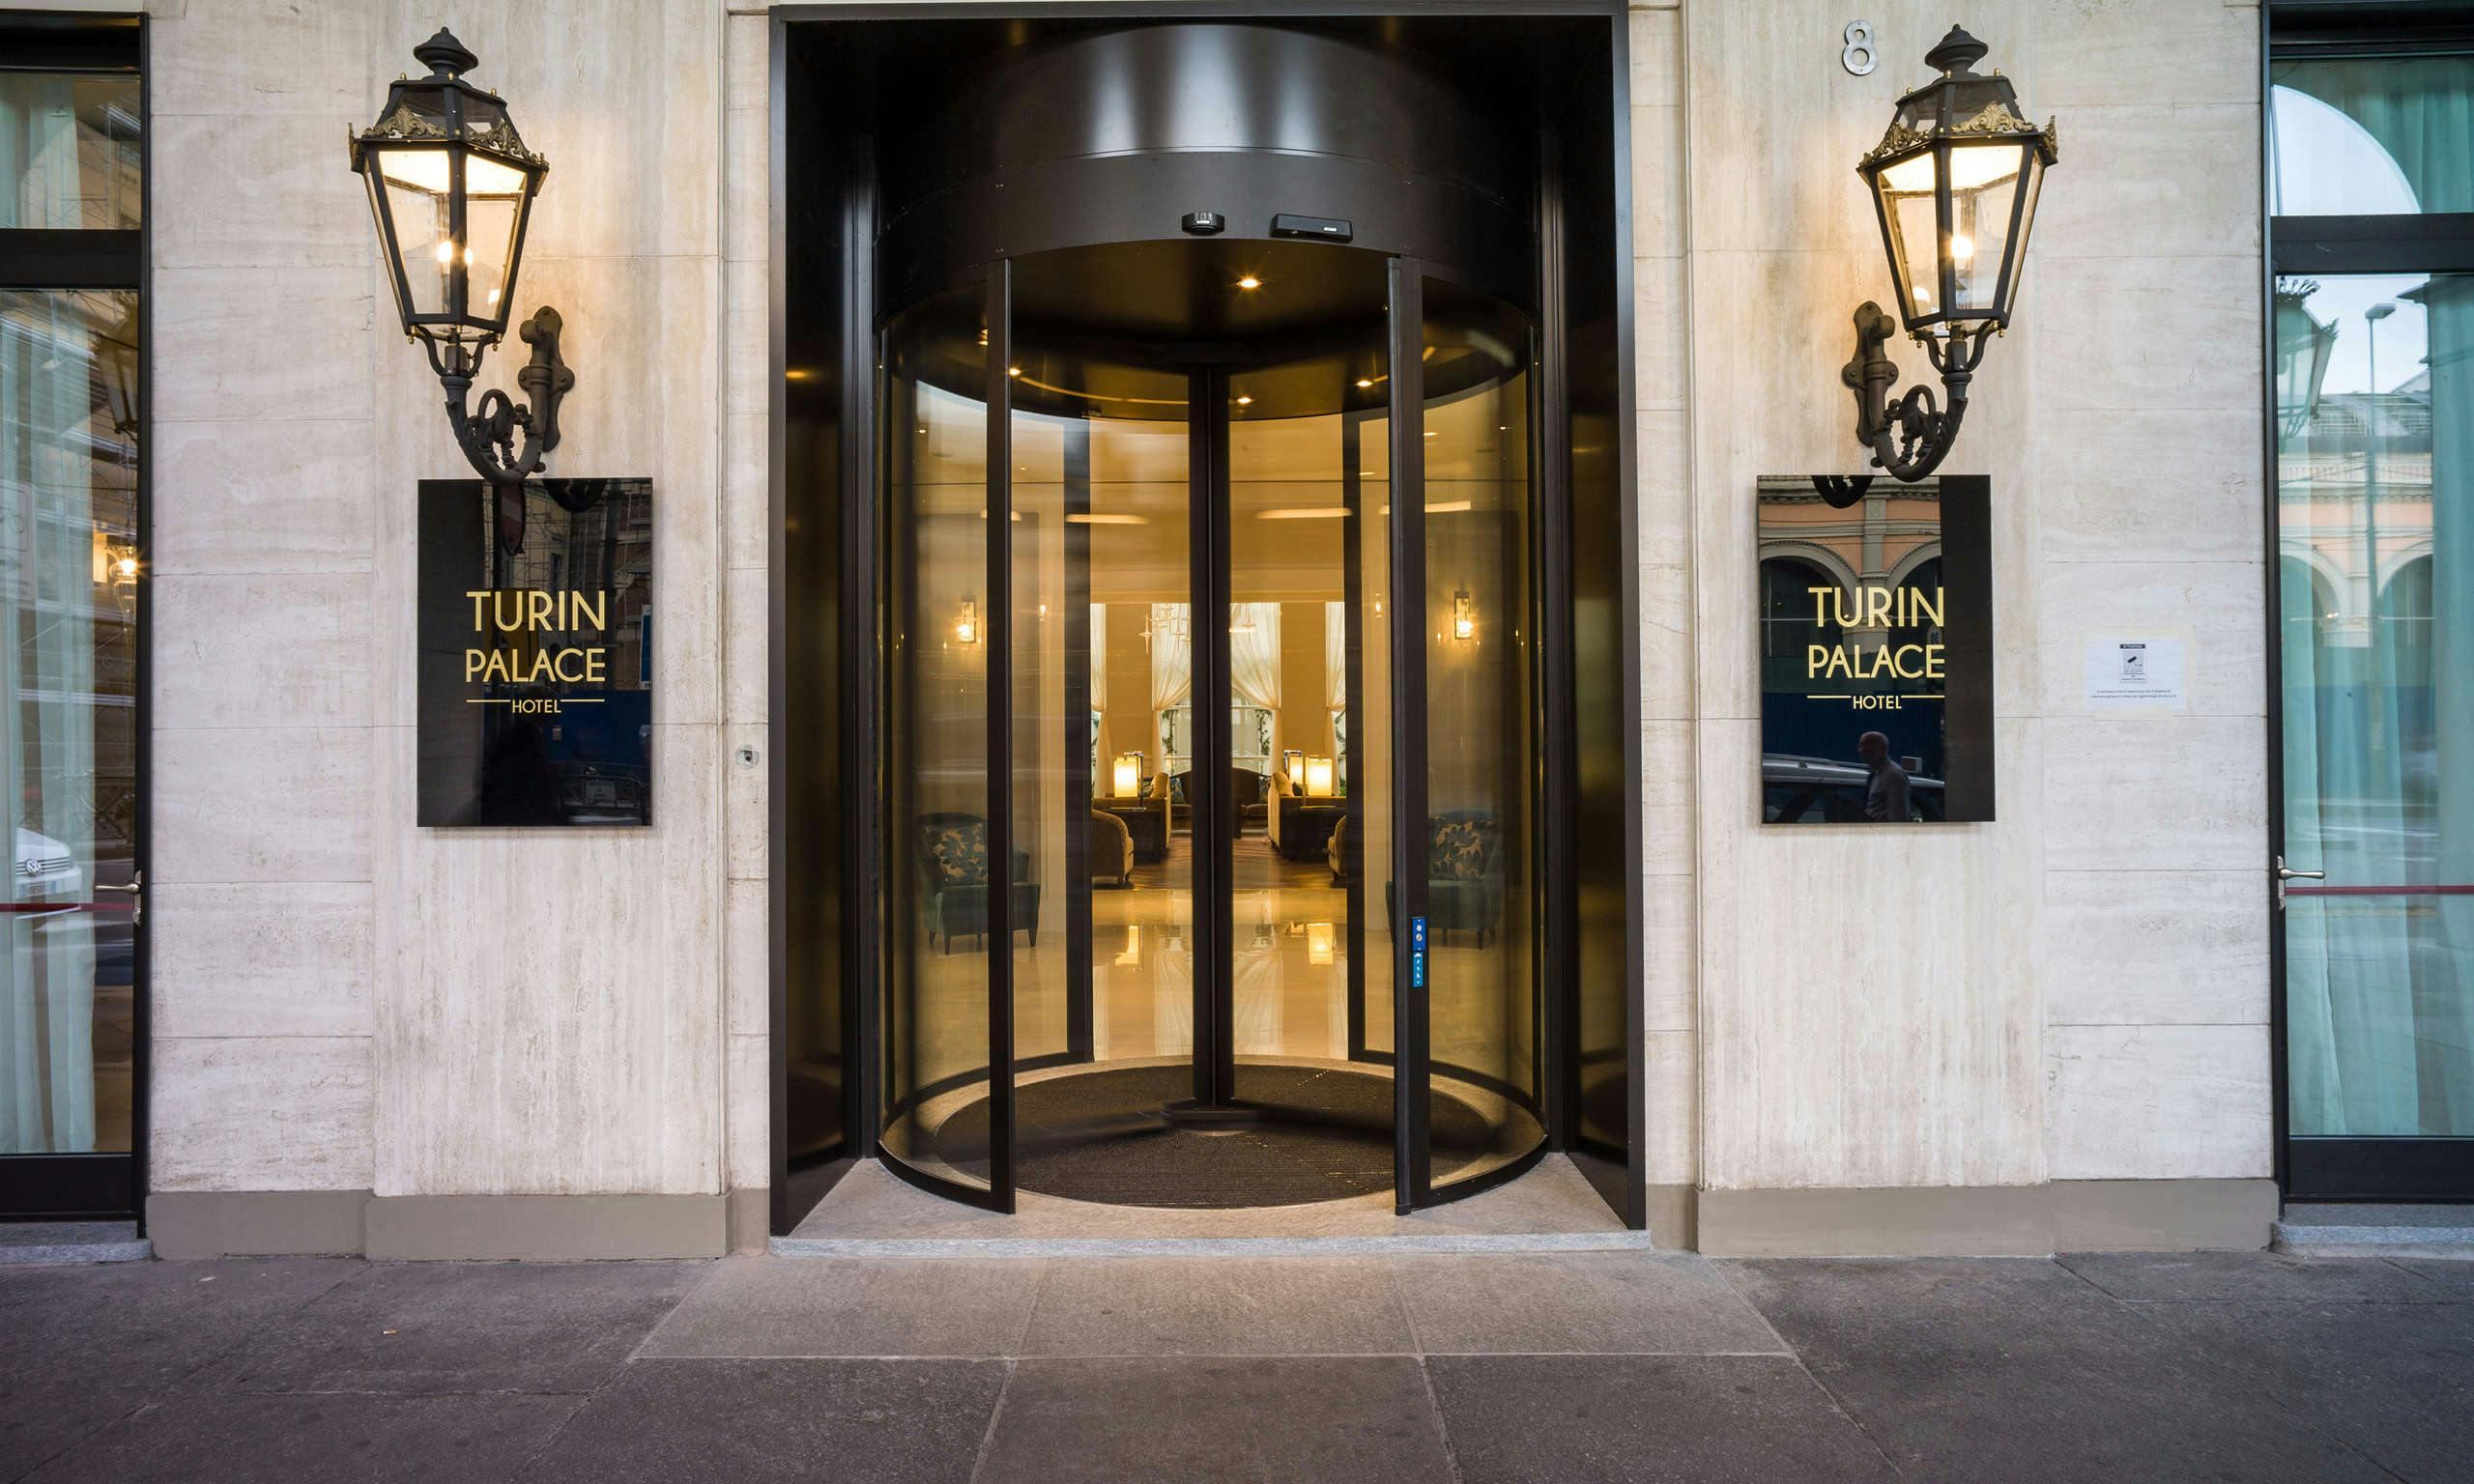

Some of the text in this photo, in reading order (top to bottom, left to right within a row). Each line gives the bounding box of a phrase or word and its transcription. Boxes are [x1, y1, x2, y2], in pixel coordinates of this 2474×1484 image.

[1842, 19, 1878, 76] 8
[466, 590, 606, 632] TURIN
[1807, 586, 1944, 628] TURIN
[465, 648, 606, 683] PALACE
[1808, 644, 1945, 678] PALACE
[512, 699, 561, 714] HOTEL
[1853, 696, 1902, 710] HOTEL
